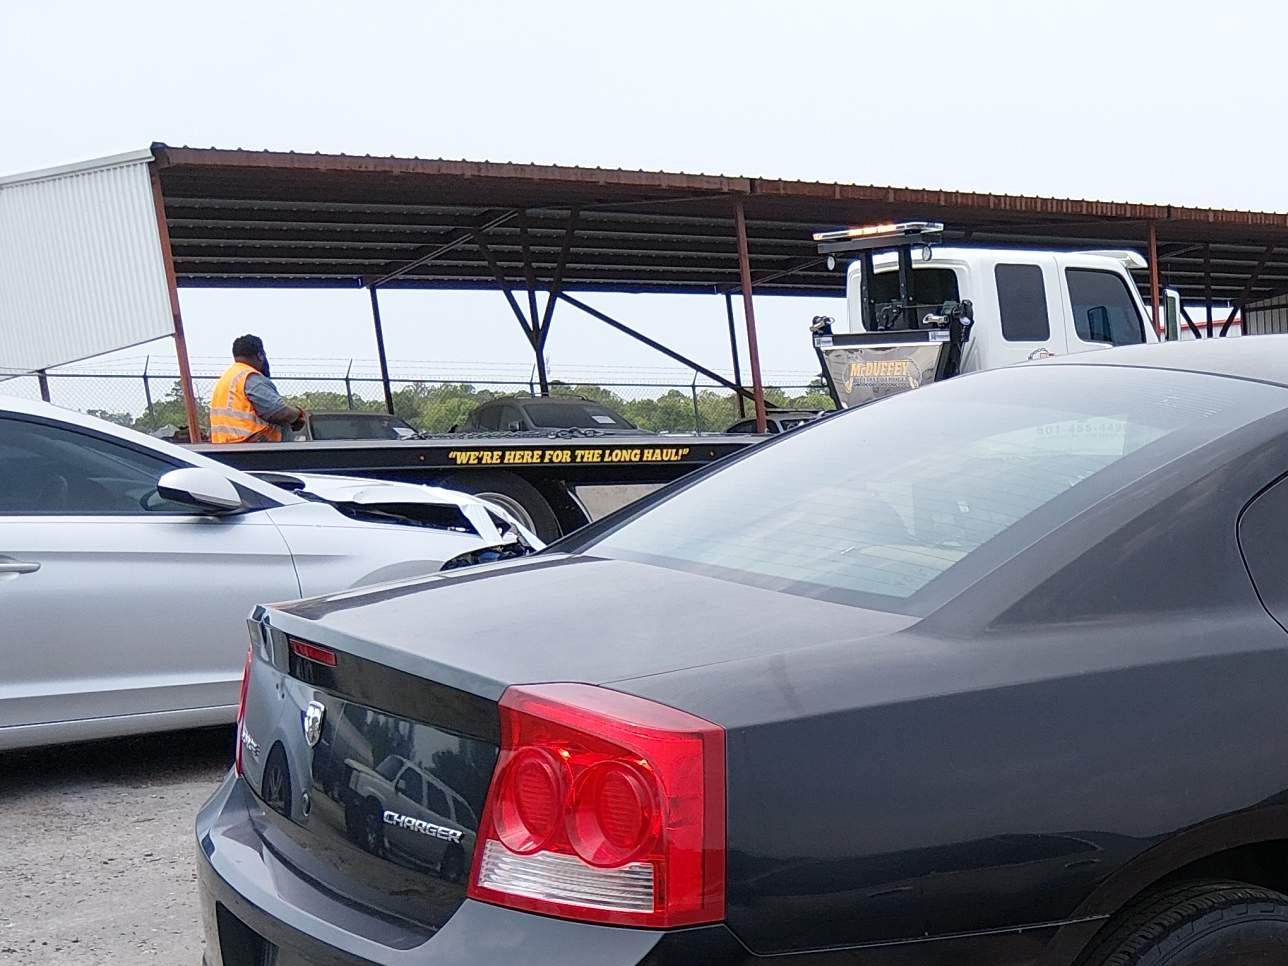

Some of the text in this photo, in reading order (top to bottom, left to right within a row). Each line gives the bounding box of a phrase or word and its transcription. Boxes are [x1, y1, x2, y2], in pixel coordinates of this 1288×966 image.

[504, 450, 542, 464] HERE
[544, 449, 571, 463] FOR
[575, 449, 601, 463] THE
[603, 449, 641, 462] LONG
[383, 810, 463, 844] CHARGER
